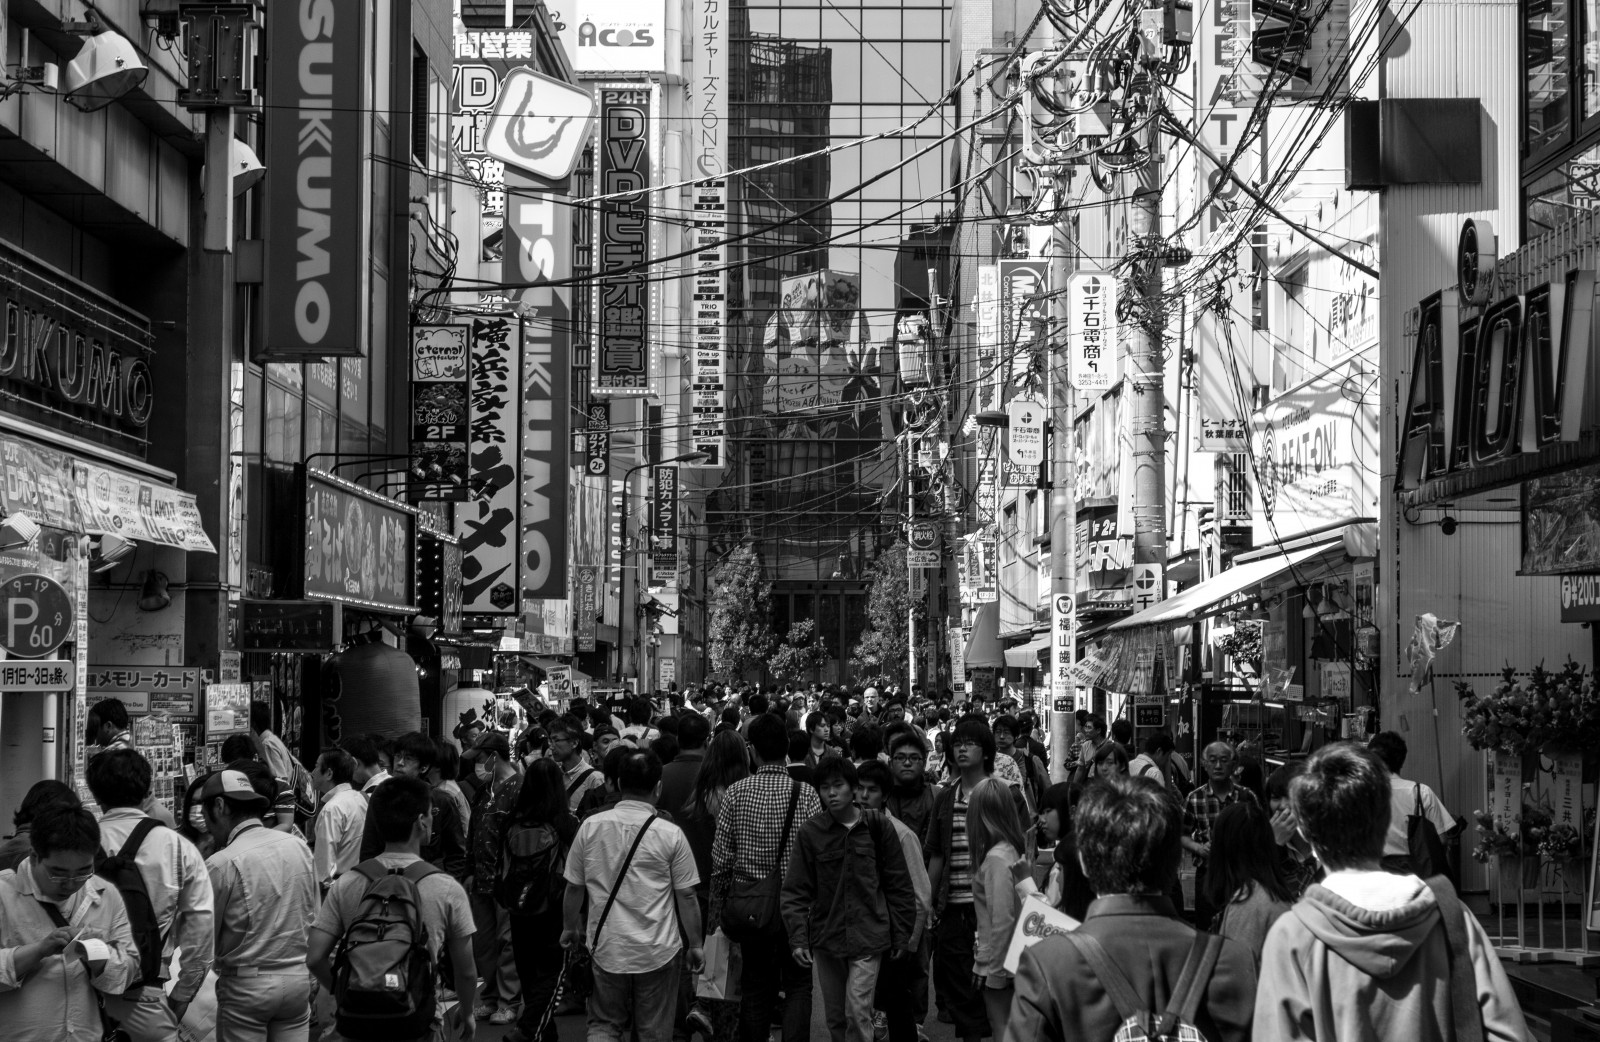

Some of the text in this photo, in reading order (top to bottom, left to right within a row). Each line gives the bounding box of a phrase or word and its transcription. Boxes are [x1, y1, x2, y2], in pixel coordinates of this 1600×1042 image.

[605, 91, 647, 105] 24H
[1083, 296, 1101, 359] 千石電商
[417, 345, 463, 356] eternal
[600, 374, 646, 388] 受付3F
[1201, 418, 1247, 428] ビートオン
[426, 425, 456, 440] 2F
[1204, 429, 1245, 439] 秋葉原店
[591, 460, 604, 470] 2F
[424, 484, 454, 499] 2F
[1101, 519, 1117, 536] 2F
[1088, 538, 1135, 572] GAM
[13, 579, 49, 593] 9-19
[7, 597, 39, 648] P
[54, 611, 63, 627] 分
[29, 624, 53, 648] 60
[1059, 618, 1071, 680] 福山歯科
[1562, 796, 1573, 823] 三共
